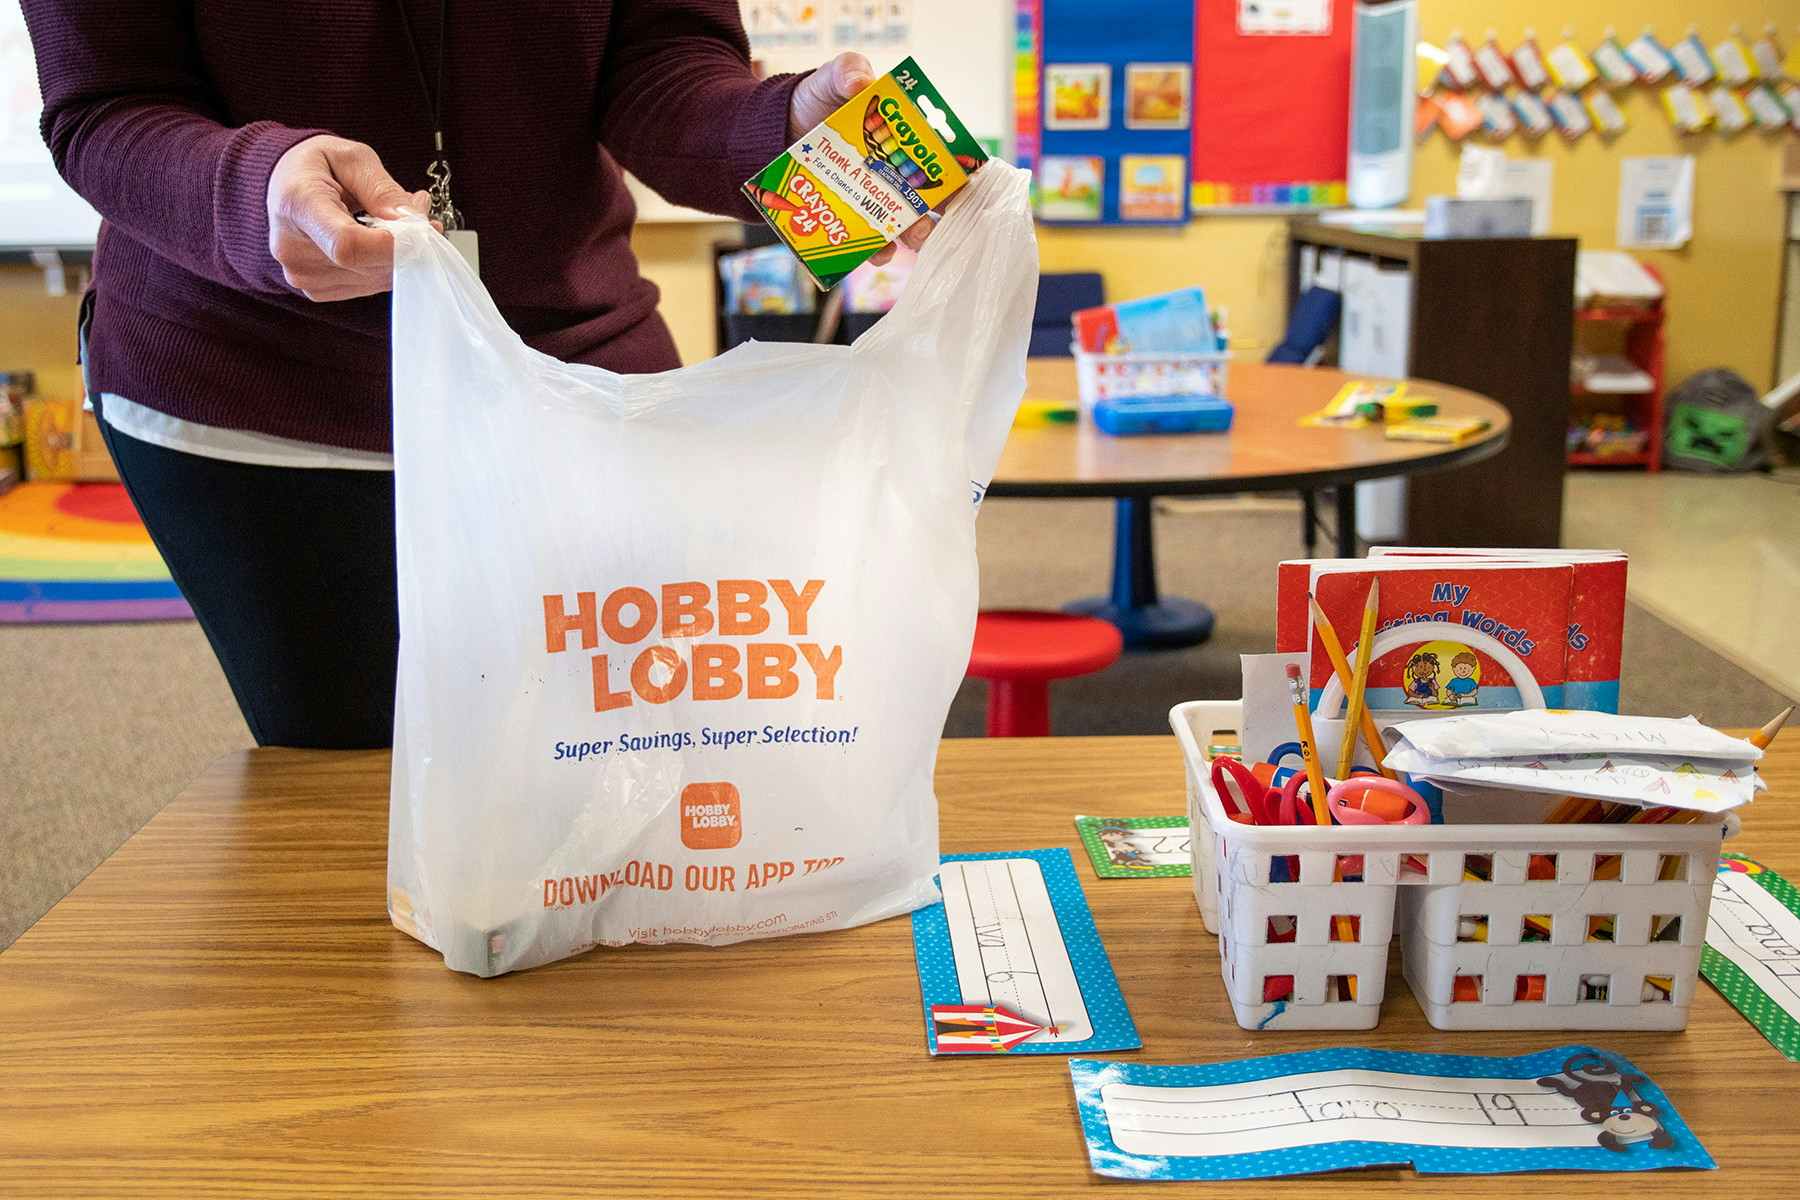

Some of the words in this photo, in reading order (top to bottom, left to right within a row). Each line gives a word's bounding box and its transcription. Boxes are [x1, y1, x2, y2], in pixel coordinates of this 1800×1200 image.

[896, 70, 918, 91] 24
[879, 97, 943, 180] Crayola
[812, 157, 825, 169] For
[831, 172, 853, 194] Chance
[853, 192, 861, 200] to
[860, 195, 888, 223] WIN!
[817, 136, 851, 173] Thank
[849, 167, 862, 180] A
[860, 173, 902, 213] Teacher
[789, 174, 849, 246] CRAYONS
[904, 187, 923, 208] 1903
[793, 209, 818, 233] 24
[1431, 582, 1470, 607] My
[543, 579, 826, 653] HOBBY
[1461, 609, 1536, 656] Words
[591, 643, 842, 713] LOBBY
[553, 740, 613, 762] Super
[618, 732, 697, 752] Savings,
[701, 728, 757, 746] Super
[761, 725, 858, 744] Selection!
[685, 803, 730, 817] HOBBY
[692, 815, 736, 829] LOBBY
[543, 860, 673, 908] DOWNLOAD
[685, 865, 735, 892] OUR
[745, 861, 795, 890] APP
[628, 925, 657, 940] Visit
[663, 910, 788, 939] hobbylobby.com
[1268, 1091, 1402, 1123] Taro
[1473, 1093, 1529, 1126] 19
